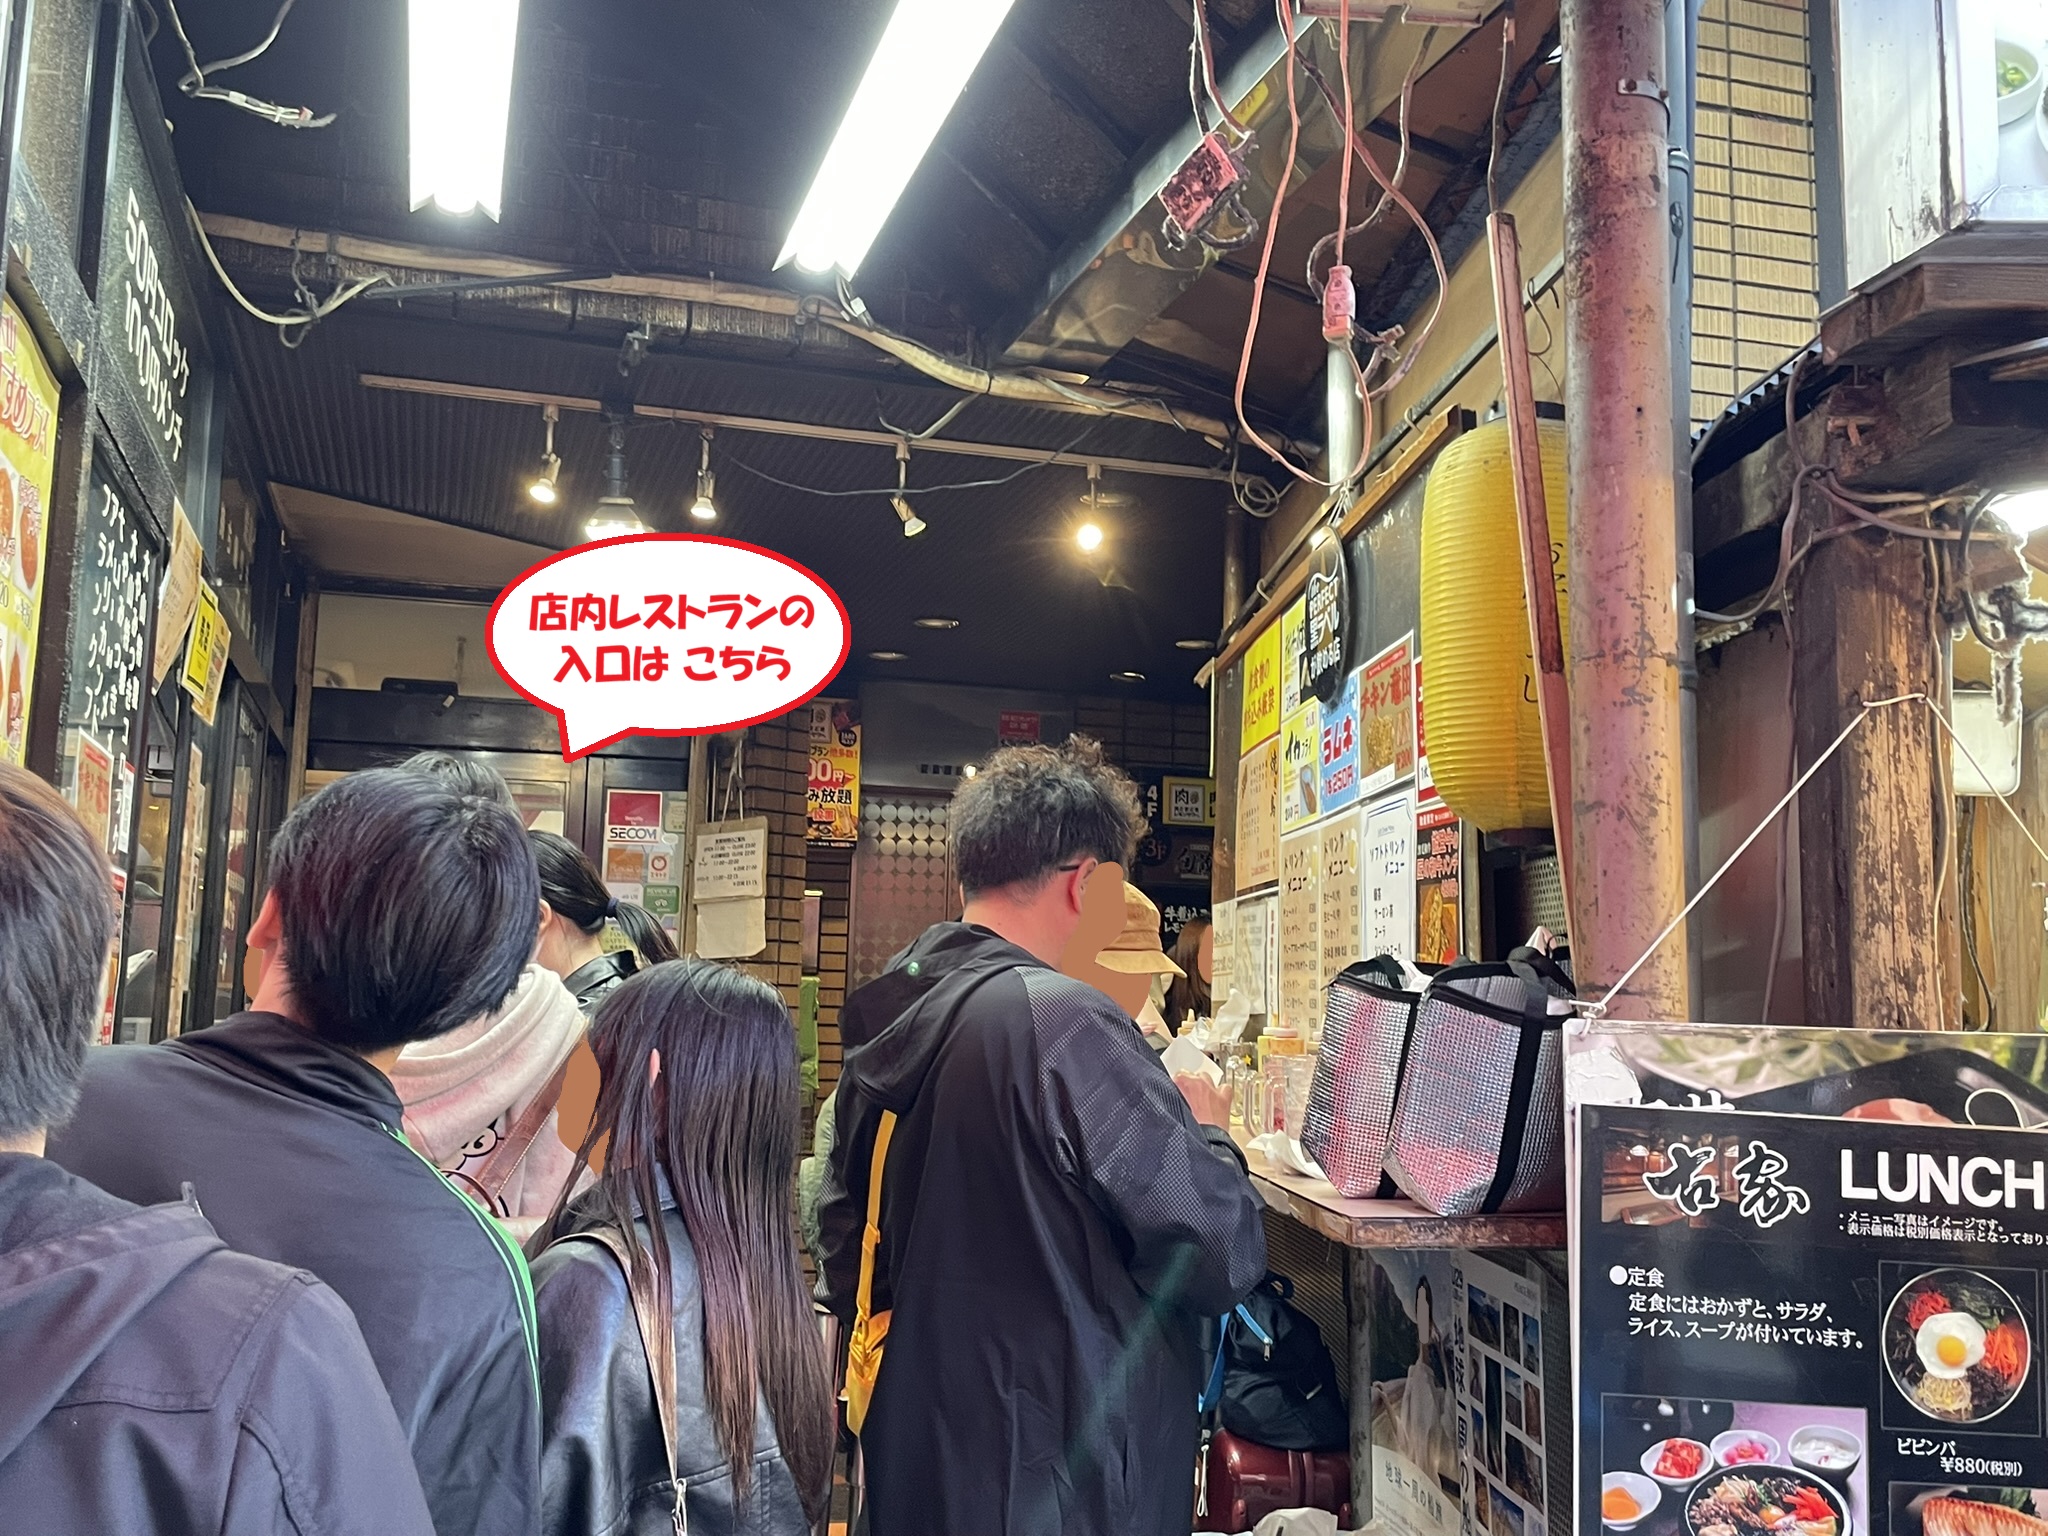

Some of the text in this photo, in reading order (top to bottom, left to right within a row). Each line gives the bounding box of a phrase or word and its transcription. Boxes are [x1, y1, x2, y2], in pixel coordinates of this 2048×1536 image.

[126, 188, 190, 397] 50円コロッケ
[125, 281, 184, 462] 100円メンチ
[1310, 579, 1339, 620] PERFECT
[1309, 605, 1340, 651] 黒ラベル
[1285, 730, 1313, 764] イカフライ
[1323, 714, 1353, 766] ラムネ
[808, 788, 852, 805] み放題
[610, 827, 657, 839] SECOM
[1324, 832, 1345, 860] ドリンク
[1284, 849, 1304, 876] ドリンク
[1370, 838, 1405, 862] ソフトドリンク
[1328, 860, 1348, 881] メニュー
[1385, 862, 1405, 876] メニュー
[1288, 877, 1307, 895] メニュー
[1840, 1148, 2045, 1210] LUNCH
[1628, 1267, 1665, 1288] 定食
[1629, 1292, 1834, 1323] 定食にはおかずと、サラダ、
[1628, 1317, 1864, 1349] ライス、スープが付いています。
